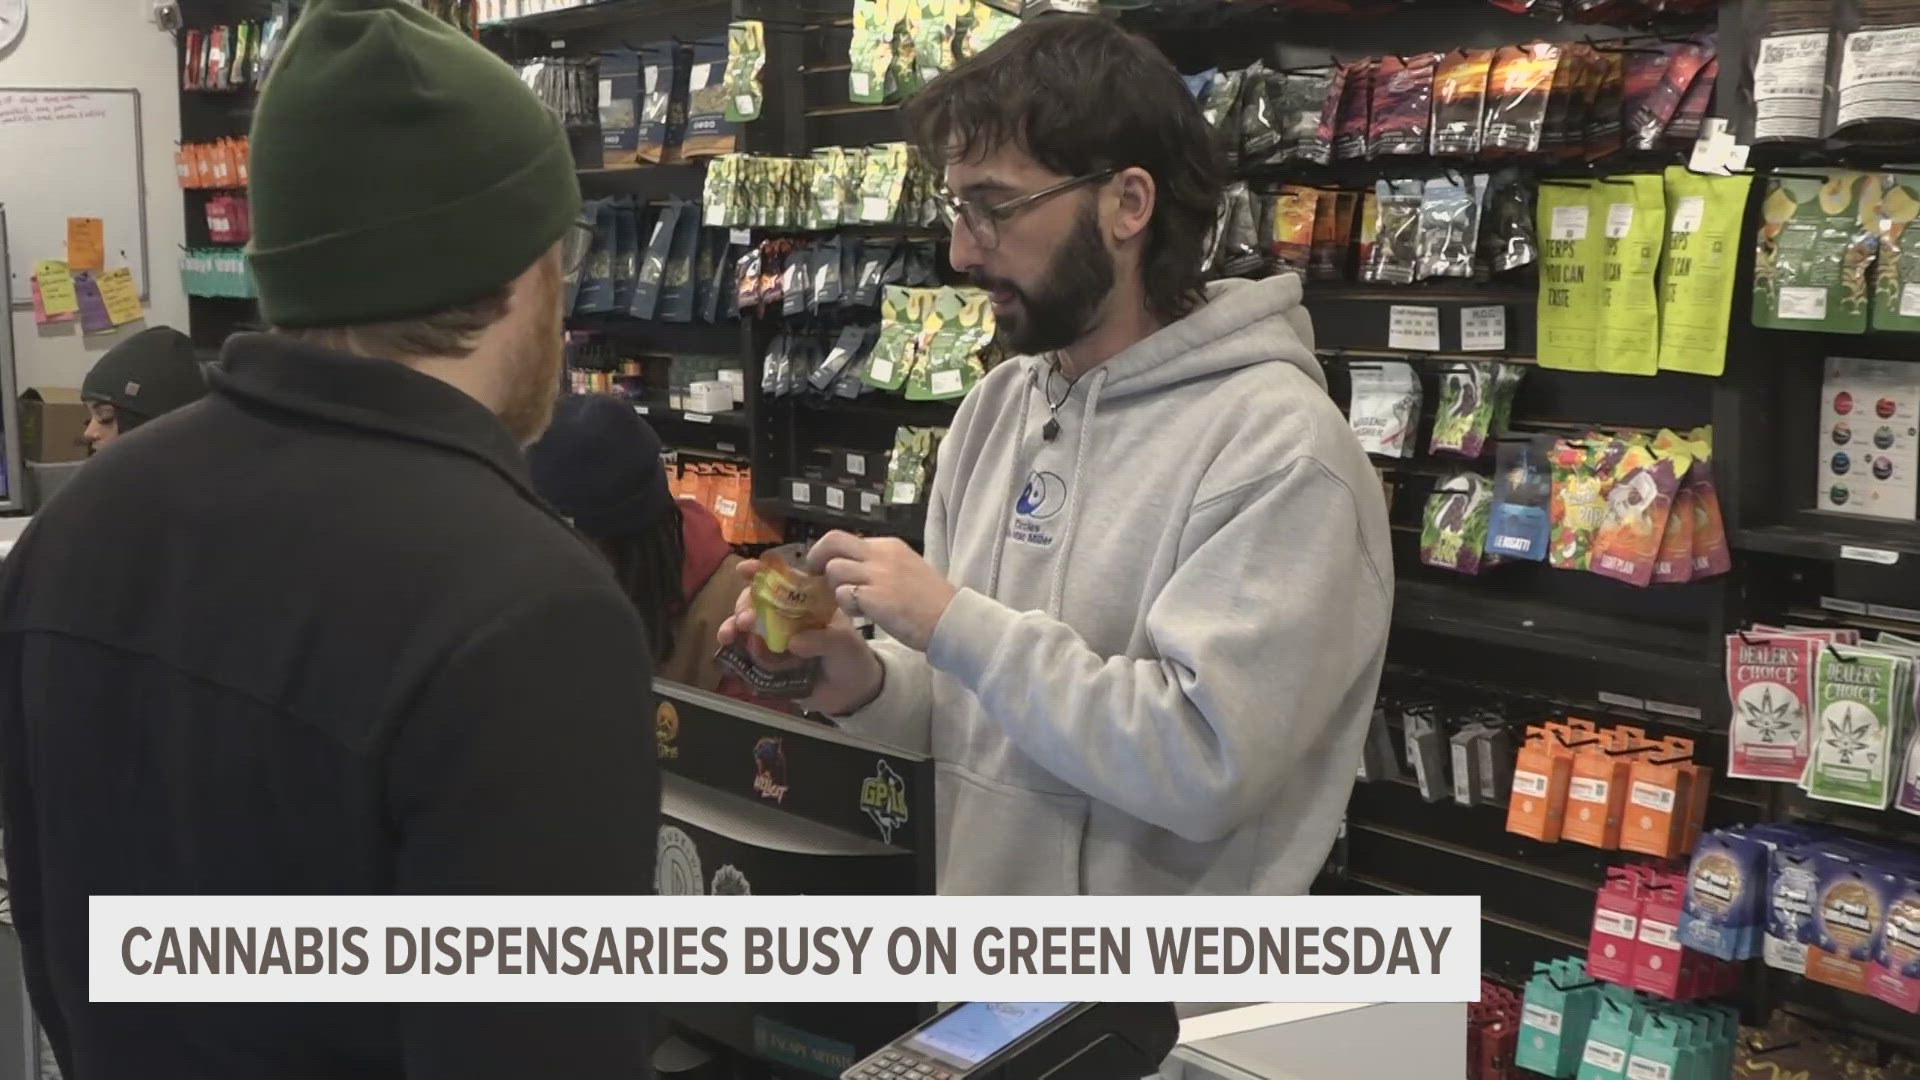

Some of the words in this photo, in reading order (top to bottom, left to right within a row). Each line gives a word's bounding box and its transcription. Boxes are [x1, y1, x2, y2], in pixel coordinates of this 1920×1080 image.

[1563, 263, 1585, 283] CAN
[1737, 665, 1799, 685] CHOICE
[1824, 683, 1882, 705] CHOICE
